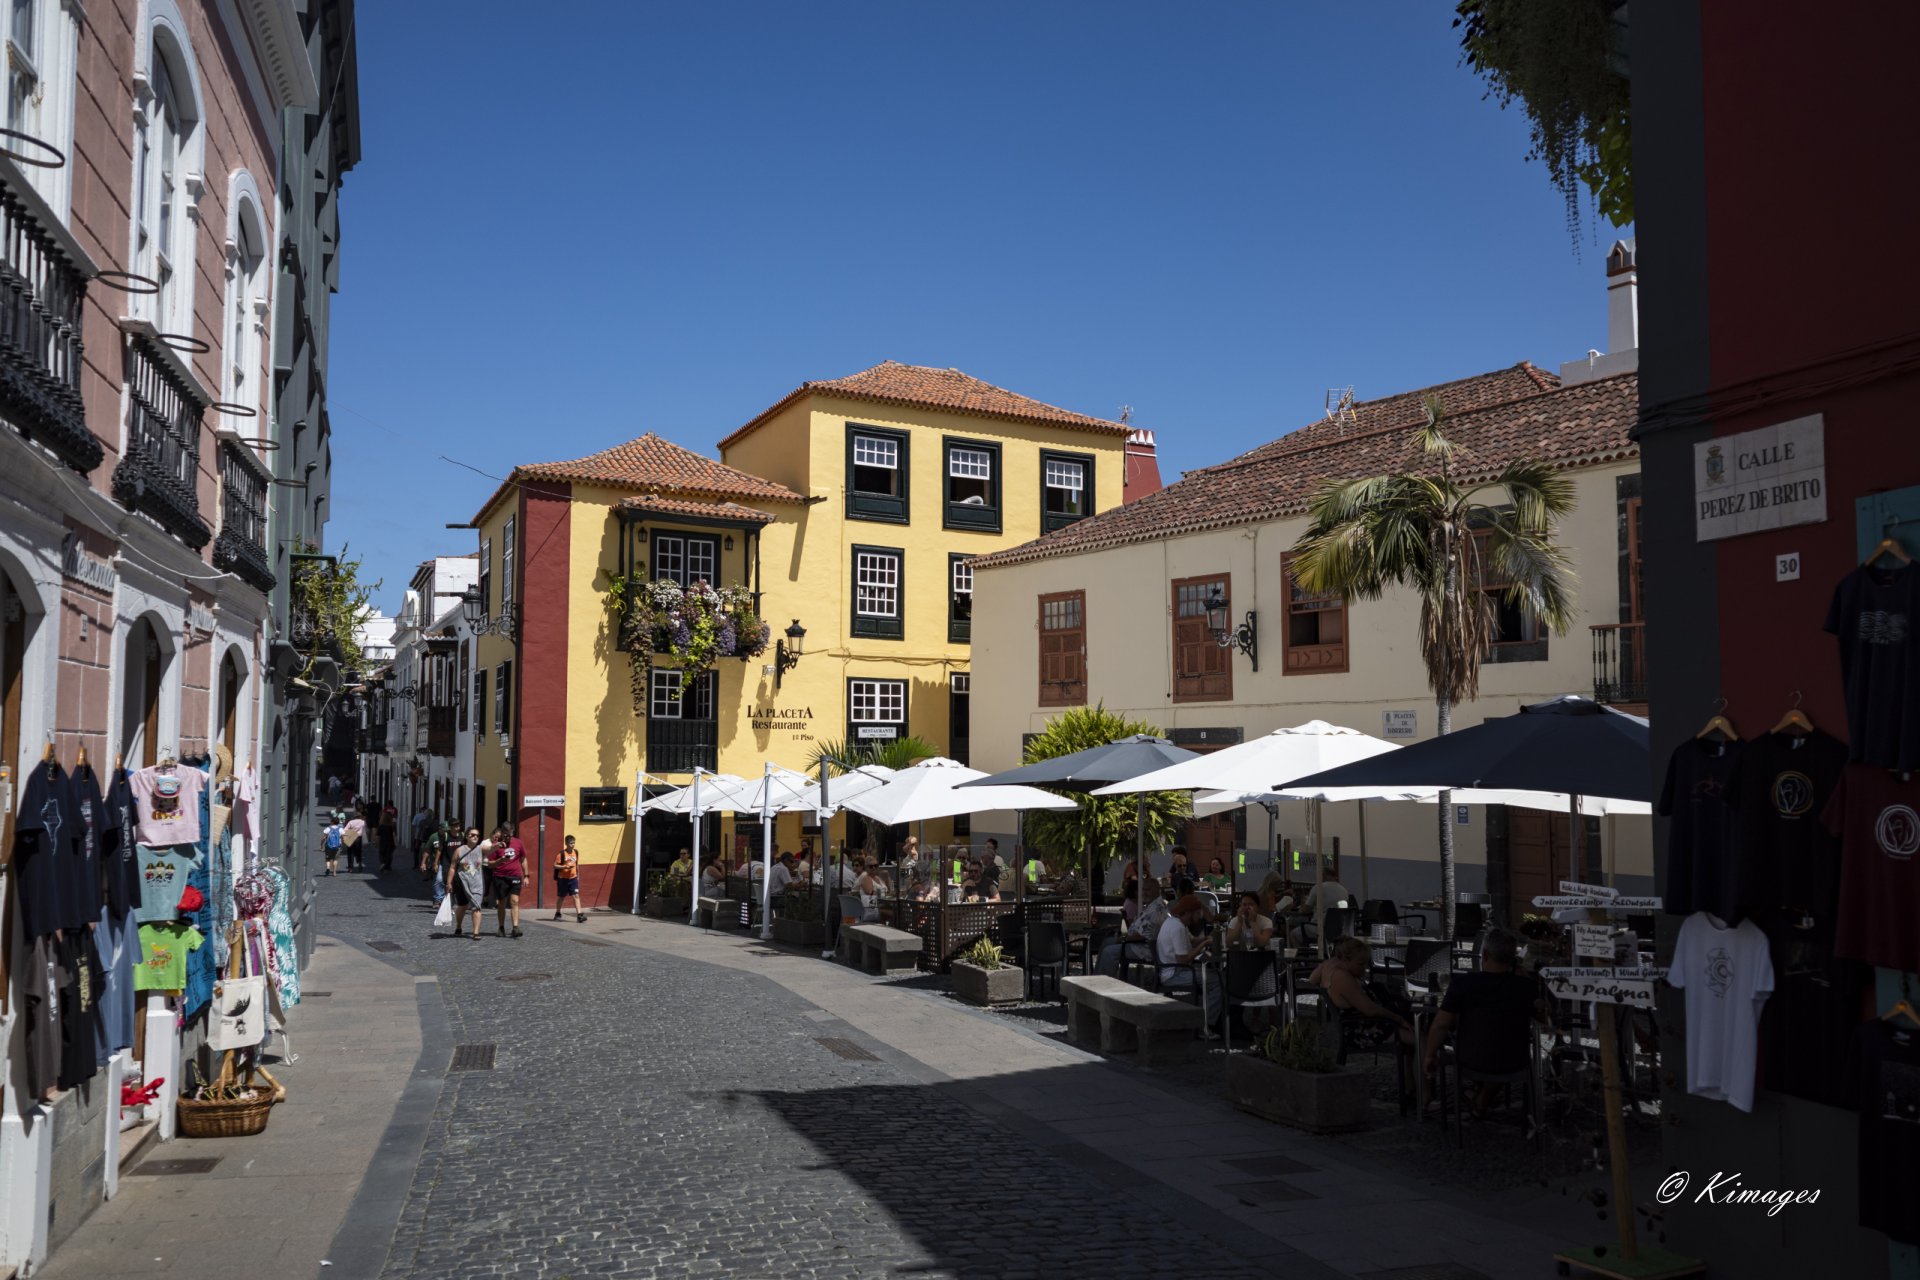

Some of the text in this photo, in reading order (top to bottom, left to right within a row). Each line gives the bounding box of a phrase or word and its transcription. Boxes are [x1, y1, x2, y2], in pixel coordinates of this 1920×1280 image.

[1739, 442, 1795, 470] CALLE
[1700, 478, 1821, 520] PEREZ DE BRITO
[1779, 558, 1797, 574] 30
[752, 719, 807, 730] Restaurante
[801, 733, 815, 741] Piso
